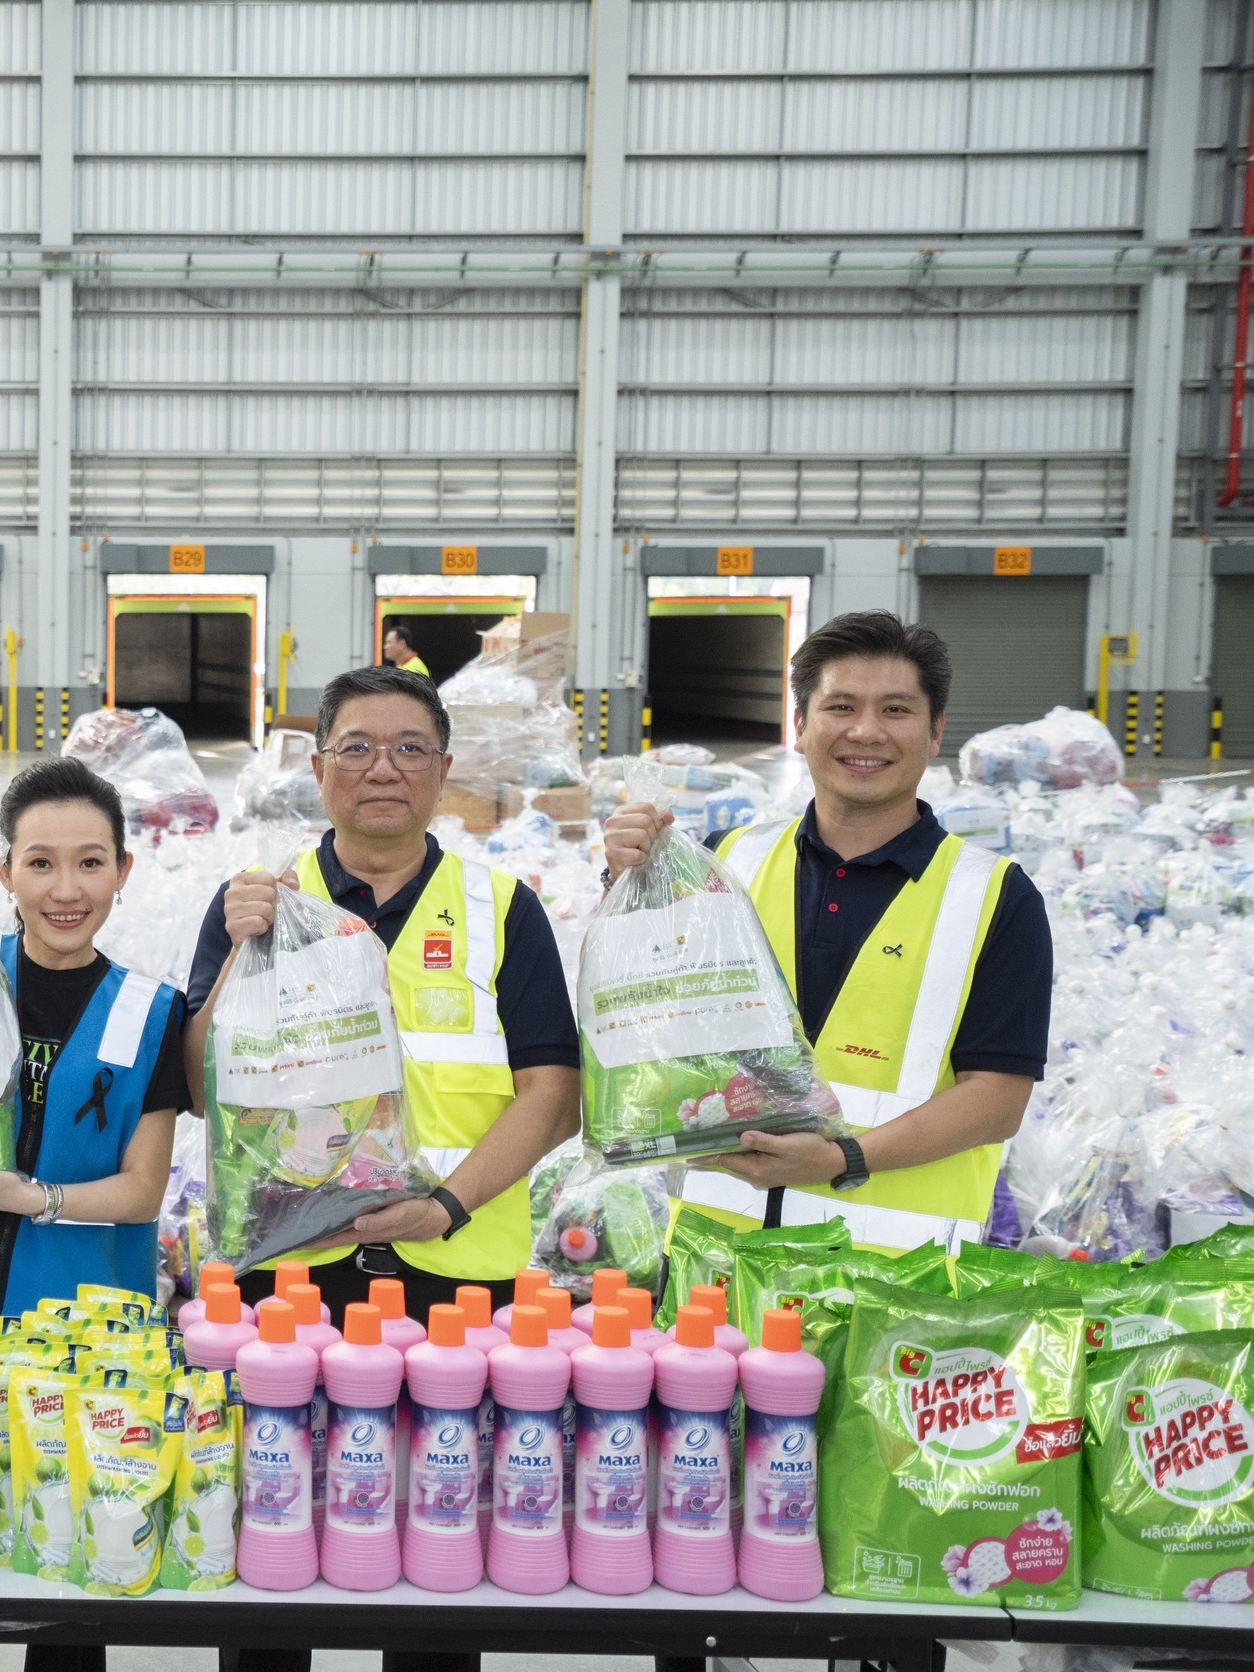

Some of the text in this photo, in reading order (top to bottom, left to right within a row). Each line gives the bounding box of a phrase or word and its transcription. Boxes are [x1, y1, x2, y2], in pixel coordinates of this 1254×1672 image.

[173, 551, 201, 567] B29
[446, 552, 474, 567] B30
[721, 553, 749, 568] B31
[998, 553, 1027, 569] B32
[842, 1044, 883, 1060] DHL
[780, 1295, 795, 1306] Big
[900, 1345, 916, 1359] Big
[899, 1351, 928, 1377] C
[910, 1363, 1008, 1412] HAPPY
[90, 1407, 124, 1421] HAPPY
[916, 1388, 1017, 1441] PRICE
[91, 1417, 125, 1431] PRICE
[1142, 1399, 1234, 1460] HAPPY
[249, 1448, 290, 1463] Maxa
[340, 1450, 384, 1464] Maxa
[426, 1451, 469, 1465] Maxa
[508, 1454, 551, 1468] Maxa
[598, 1454, 641, 1467] Maxa
[674, 1454, 719, 1468] Maxa
[1153, 1423, 1249, 1490] PRICE
[770, 1459, 813, 1473] Maxa
[919, 1496, 1019, 1511] WASHING POWDER
[1018, 1536, 1053, 1550] ซักง่าย
[1162, 1541, 1213, 1553] WASHING
[1012, 1546, 1064, 1560] สลายคราบ
[1016, 1557, 1063, 1571] สะอาด หอม
[1023, 1594, 1057, 1610] 3.5 kg
